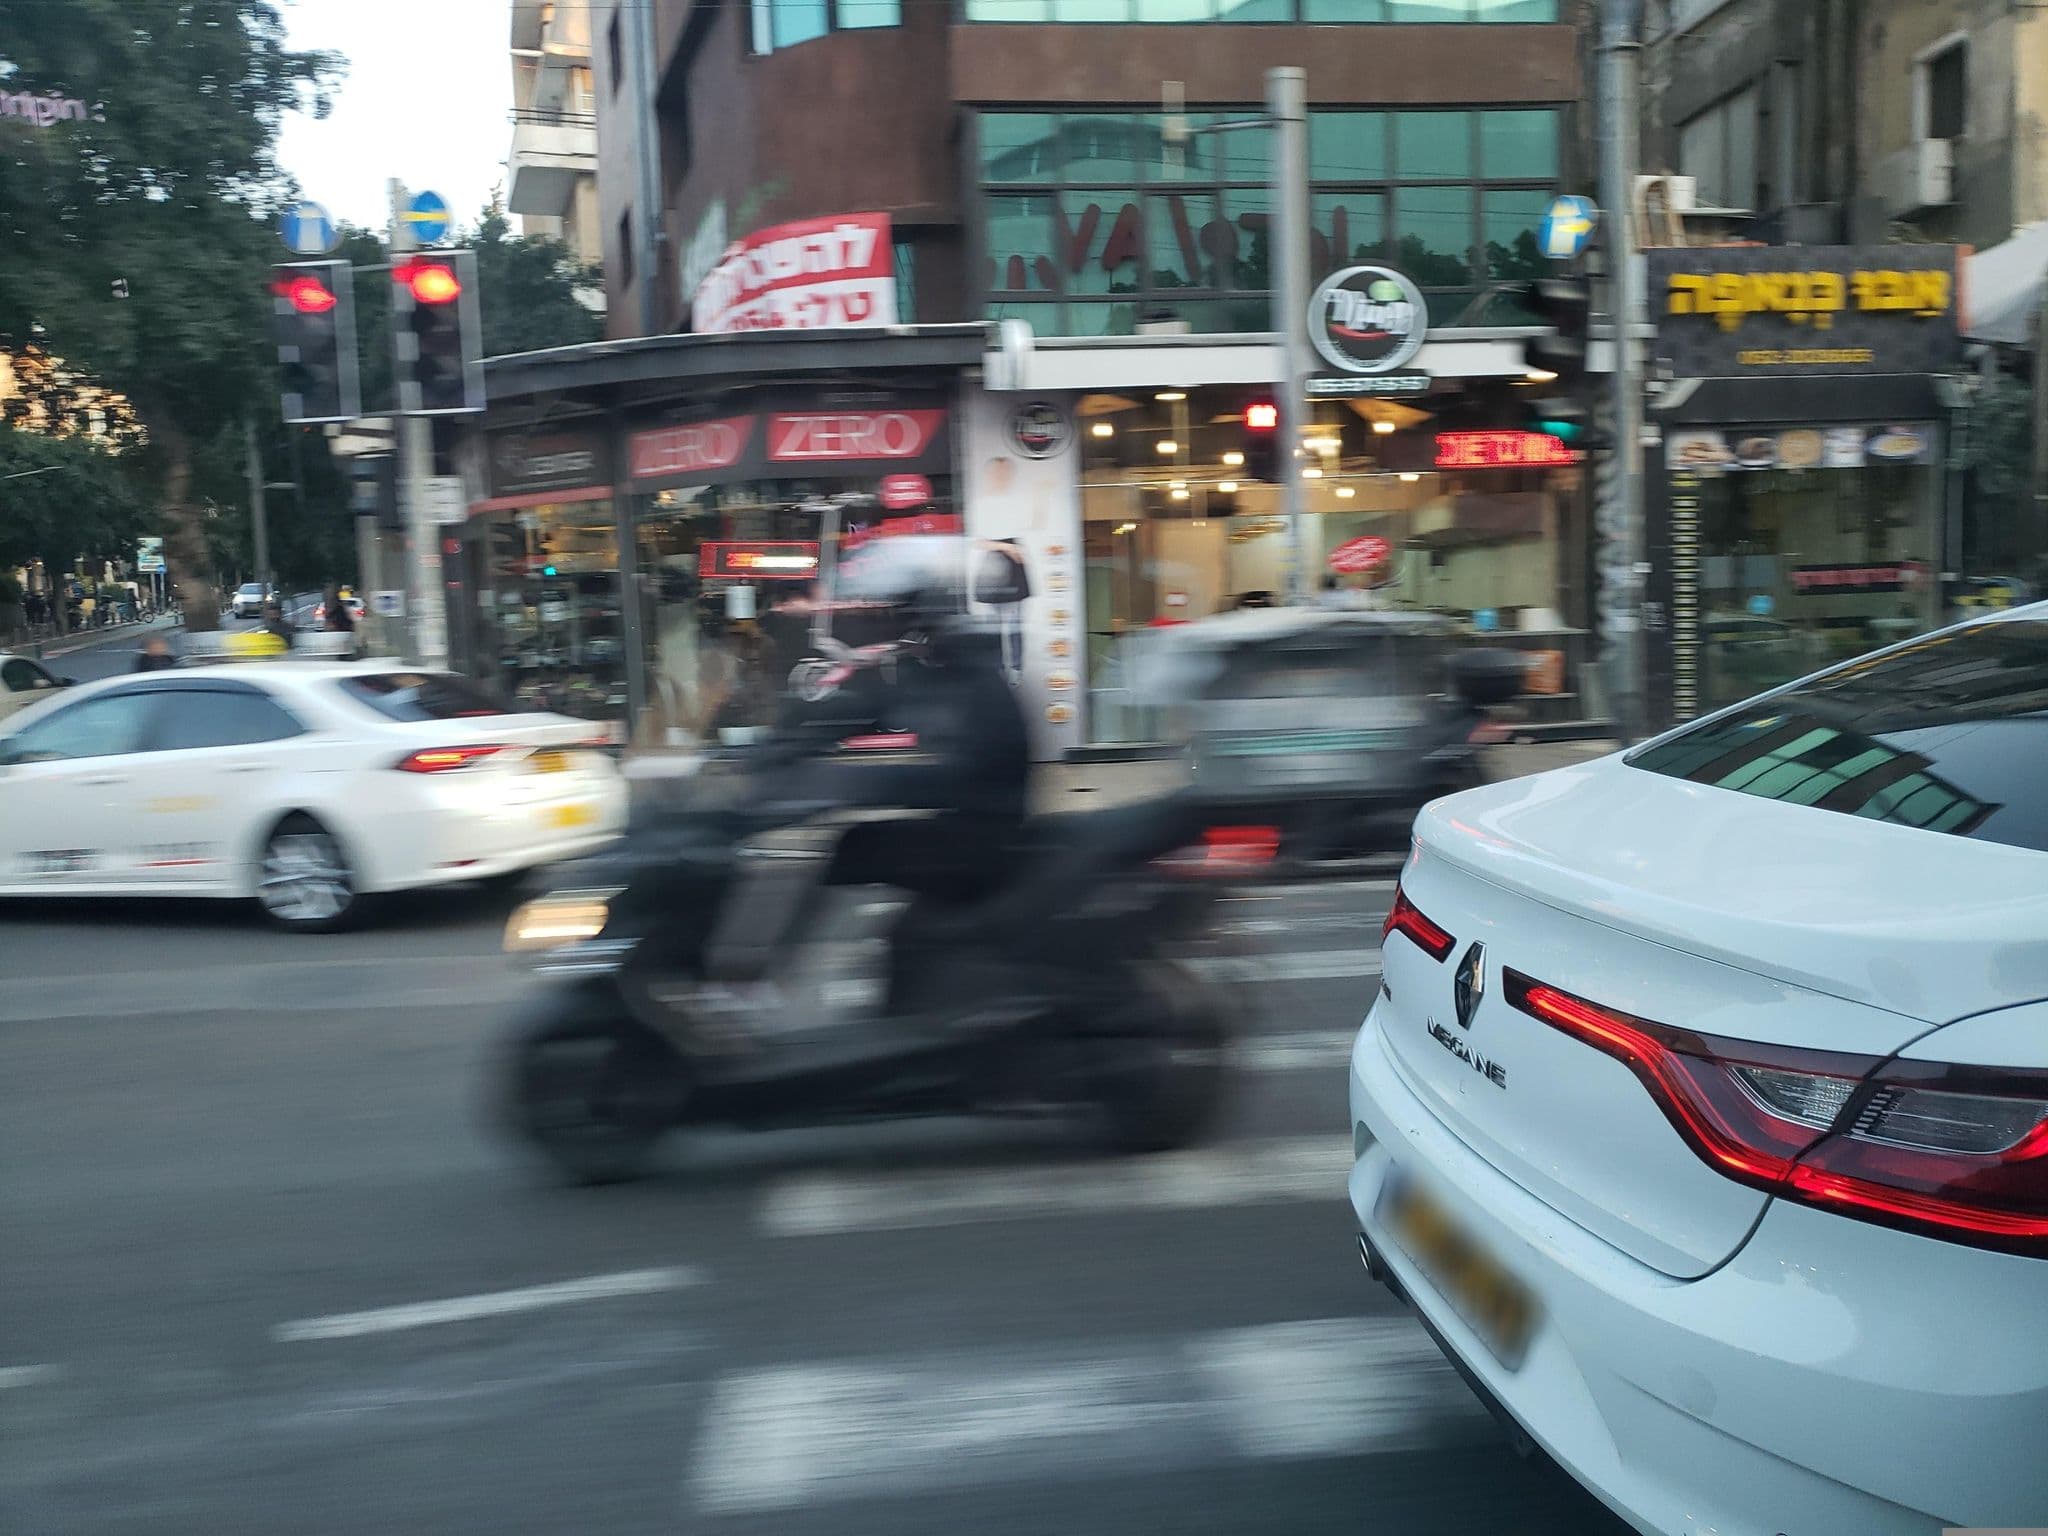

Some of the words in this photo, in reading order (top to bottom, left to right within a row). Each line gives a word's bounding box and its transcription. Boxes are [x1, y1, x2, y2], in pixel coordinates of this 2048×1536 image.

[634, 421, 740, 474] ZERO
[774, 413, 923, 456] ZERO
[1427, 1016, 1507, 1090] MEGANE
